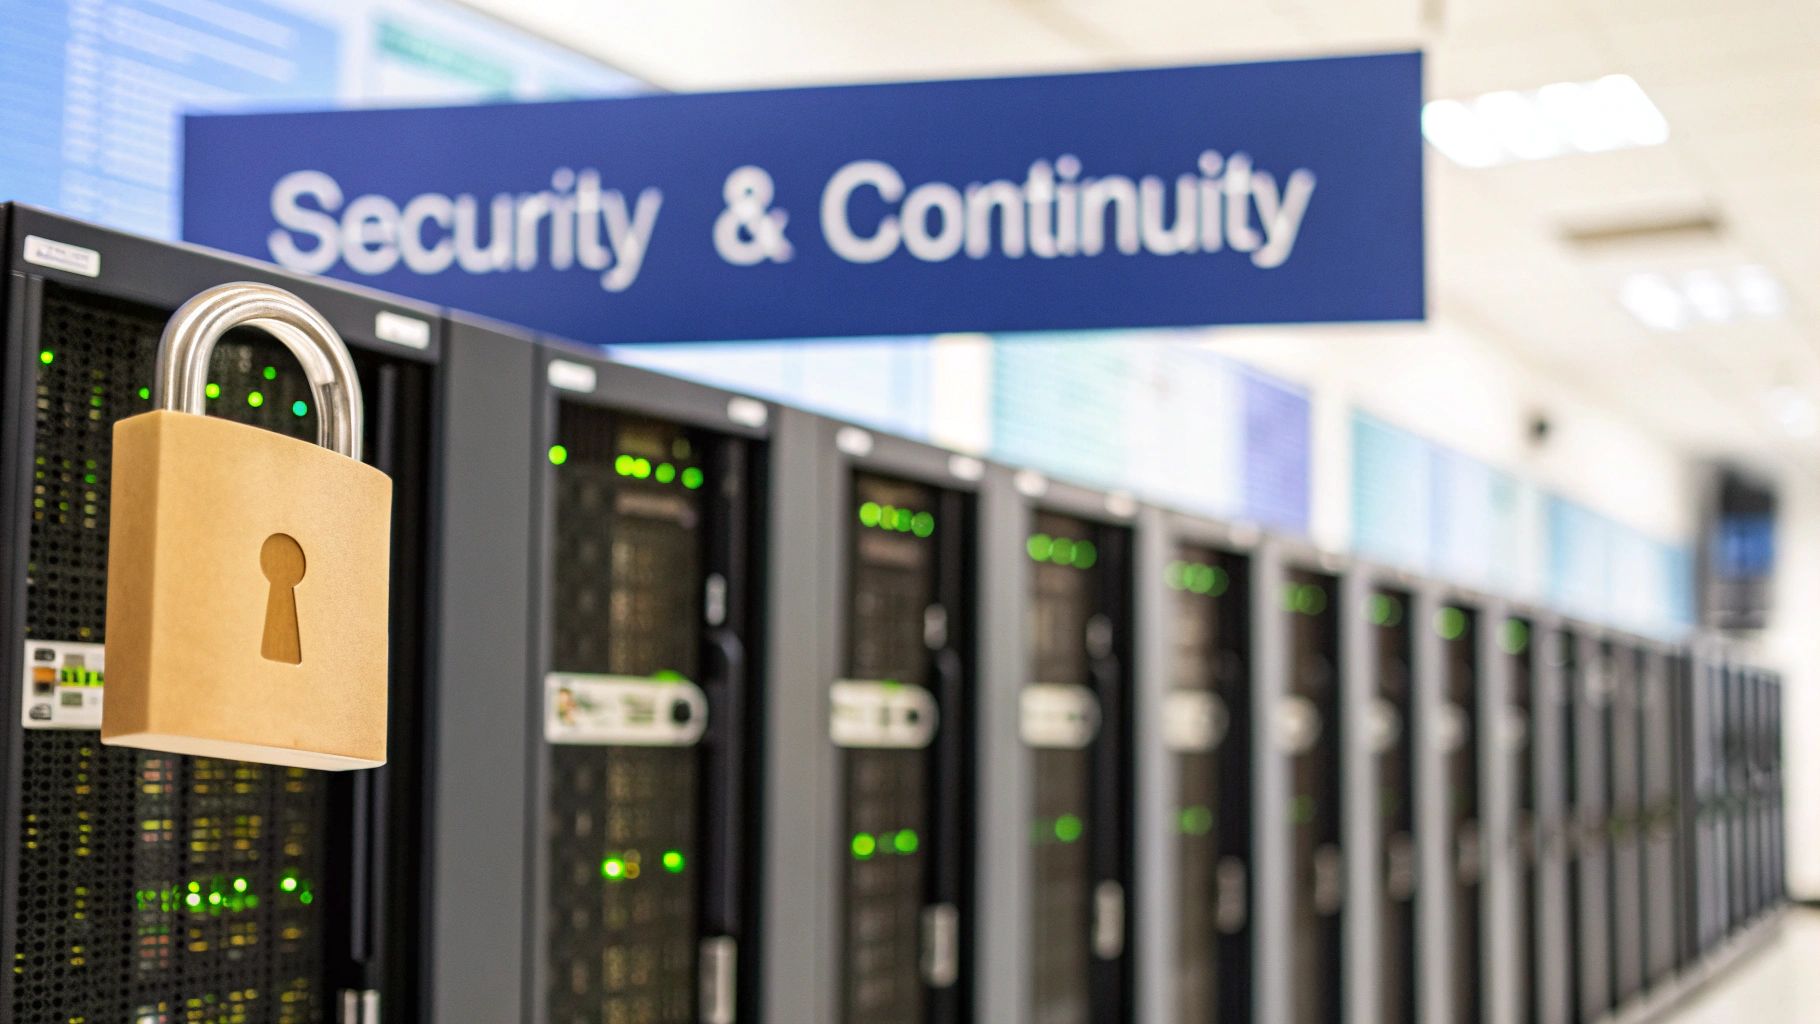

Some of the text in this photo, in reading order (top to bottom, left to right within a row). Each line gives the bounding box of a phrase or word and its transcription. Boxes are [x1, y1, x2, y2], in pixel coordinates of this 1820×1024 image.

[269, 151, 1315, 291] Security & Continuity
